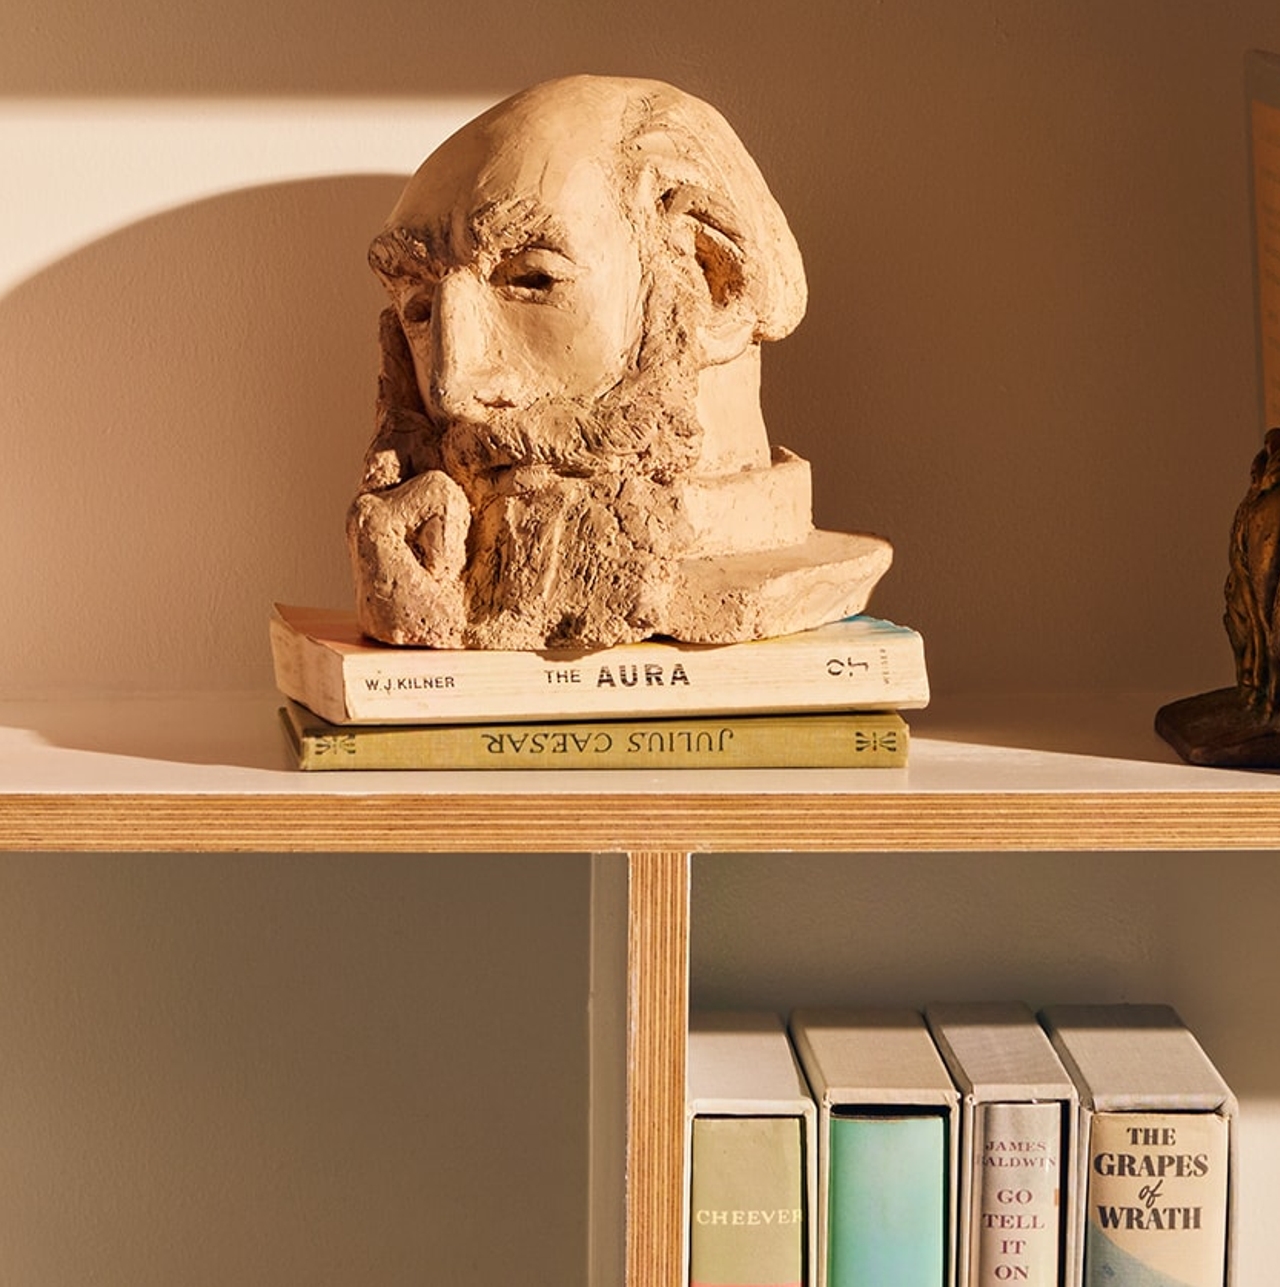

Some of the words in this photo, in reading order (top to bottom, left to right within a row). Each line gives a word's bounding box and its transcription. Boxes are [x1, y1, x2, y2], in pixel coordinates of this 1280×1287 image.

[544, 669, 582, 684] THE
[596, 663, 692, 689] AURA
[481, 733, 612, 755] CAESAR
[626, 727, 735, 753] JULIUS
[985, 1140, 1047, 1152] JAMES
[1126, 1127, 1176, 1147] THE
[1093, 1153, 1209, 1178] GRAPES
[996, 1189, 1033, 1205] GO
[1138, 1180, 1163, 1210] of
[696, 1209, 803, 1226] CHEEVER
[984, 1214, 1046, 1231] TELL
[1098, 1204, 1202, 1231] WRATH
[1000, 1240, 1028, 1255] IT
[994, 1265, 1030, 1281] ON
